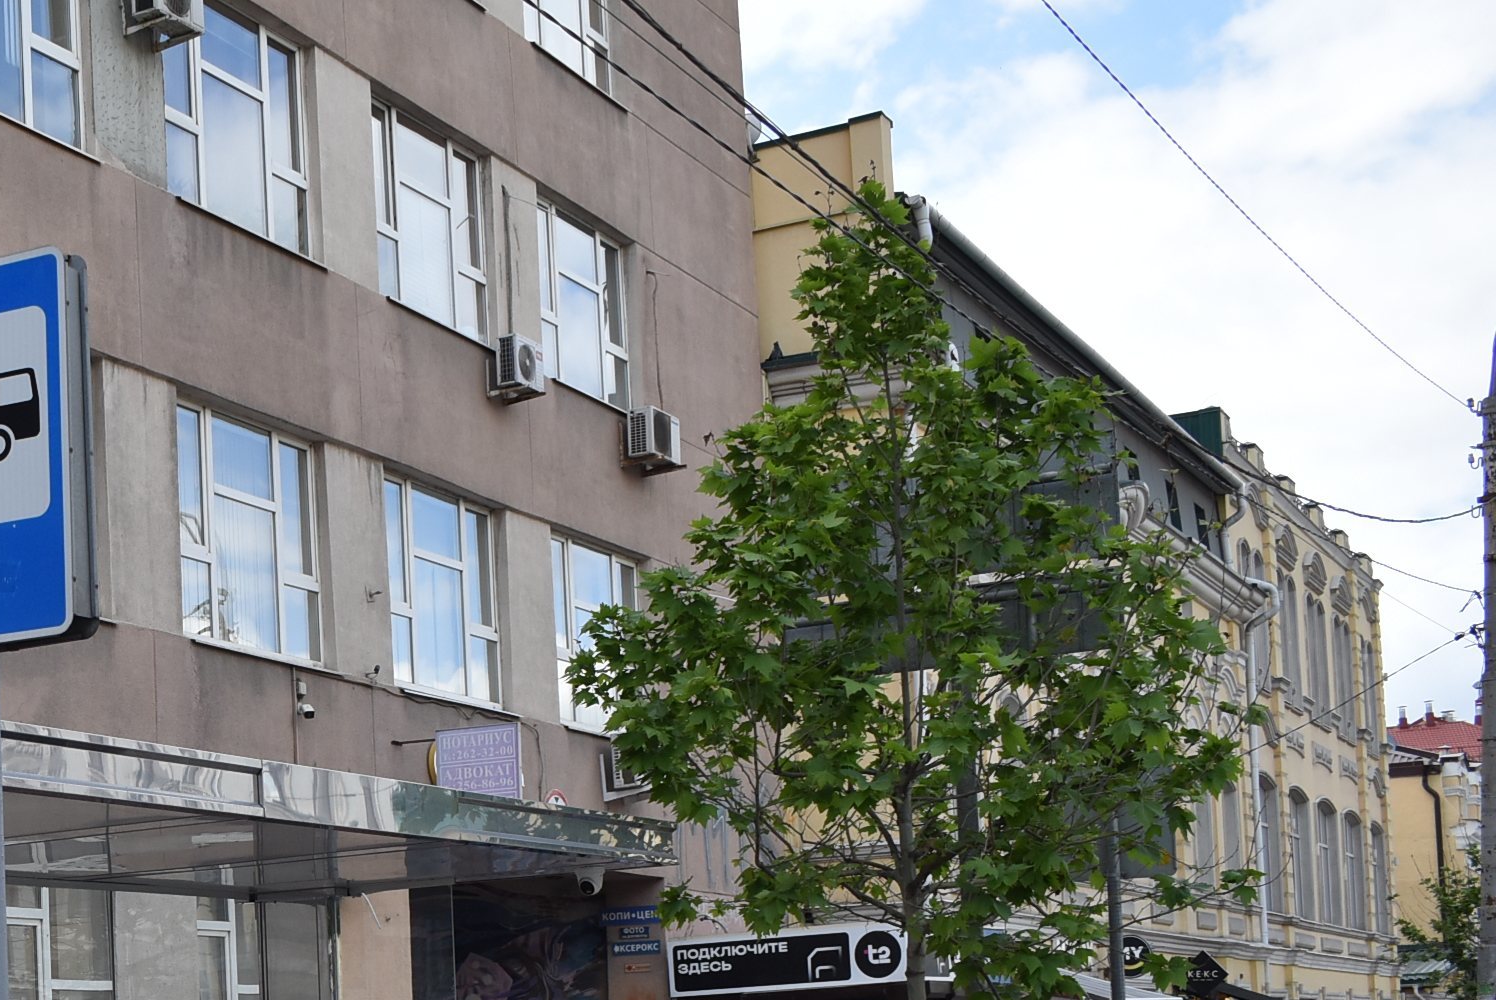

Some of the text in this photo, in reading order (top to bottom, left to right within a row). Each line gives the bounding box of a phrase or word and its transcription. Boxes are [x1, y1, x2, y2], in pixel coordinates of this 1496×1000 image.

[443, 731, 512, 750] НОТАРИУС
[444, 763, 513, 782] АДВОКАТ
[623, 926, 645, 935] ФОТО
[619, 942, 659, 952] КСЕРОКС
[676, 942, 788, 961] ПОДКЛЮЧИТЕ
[677, 961, 732, 976] ЗДЕСЬ
